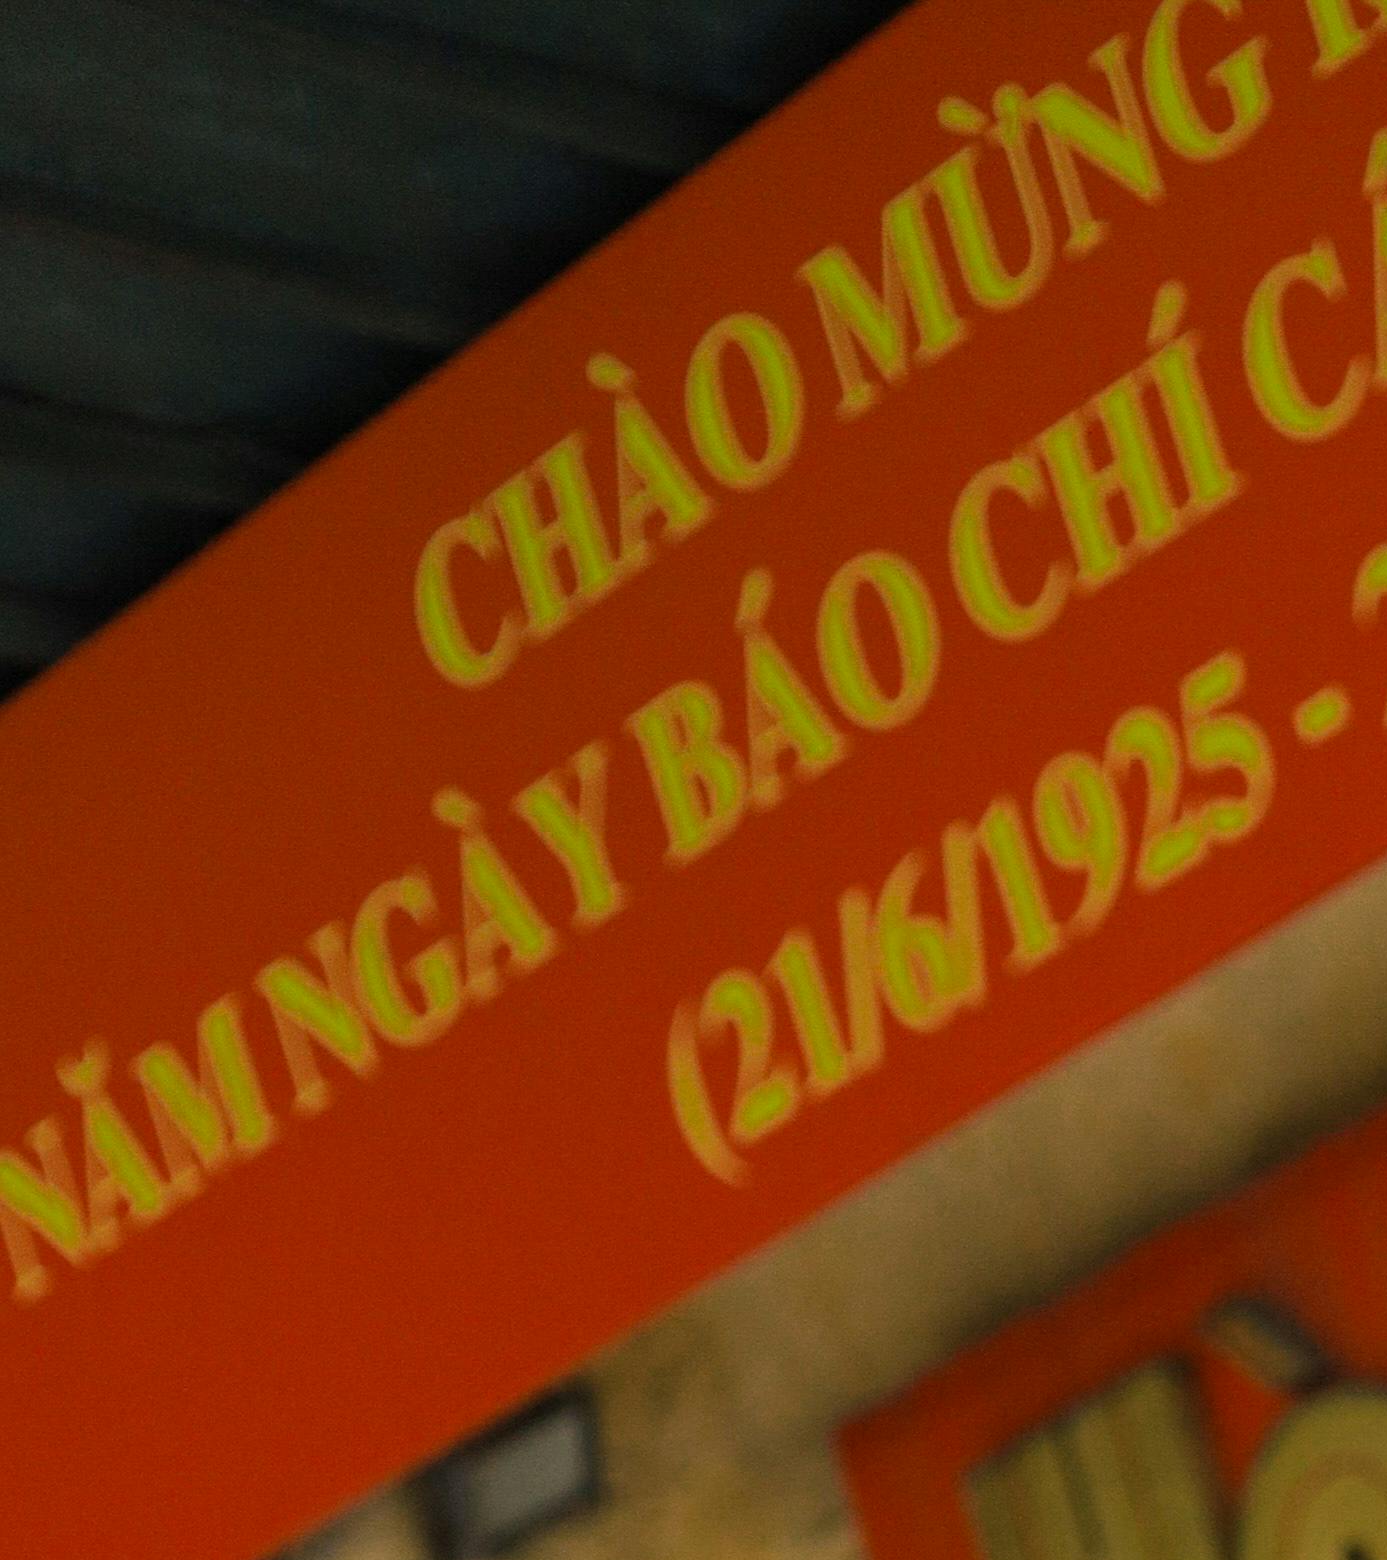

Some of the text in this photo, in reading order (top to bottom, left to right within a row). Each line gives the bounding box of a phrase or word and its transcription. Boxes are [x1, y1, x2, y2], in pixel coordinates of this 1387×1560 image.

[414, 0, 1272, 688] CHÀO MỪNG
[0, 996, 278, 1303] NĂM
[256, 741, 626, 1114] NGÀY
[623, 551, 941, 865] BÁO
[947, 281, 1250, 644] CHÍ
[666, 650, 1275, 1188] (21/6/1925
